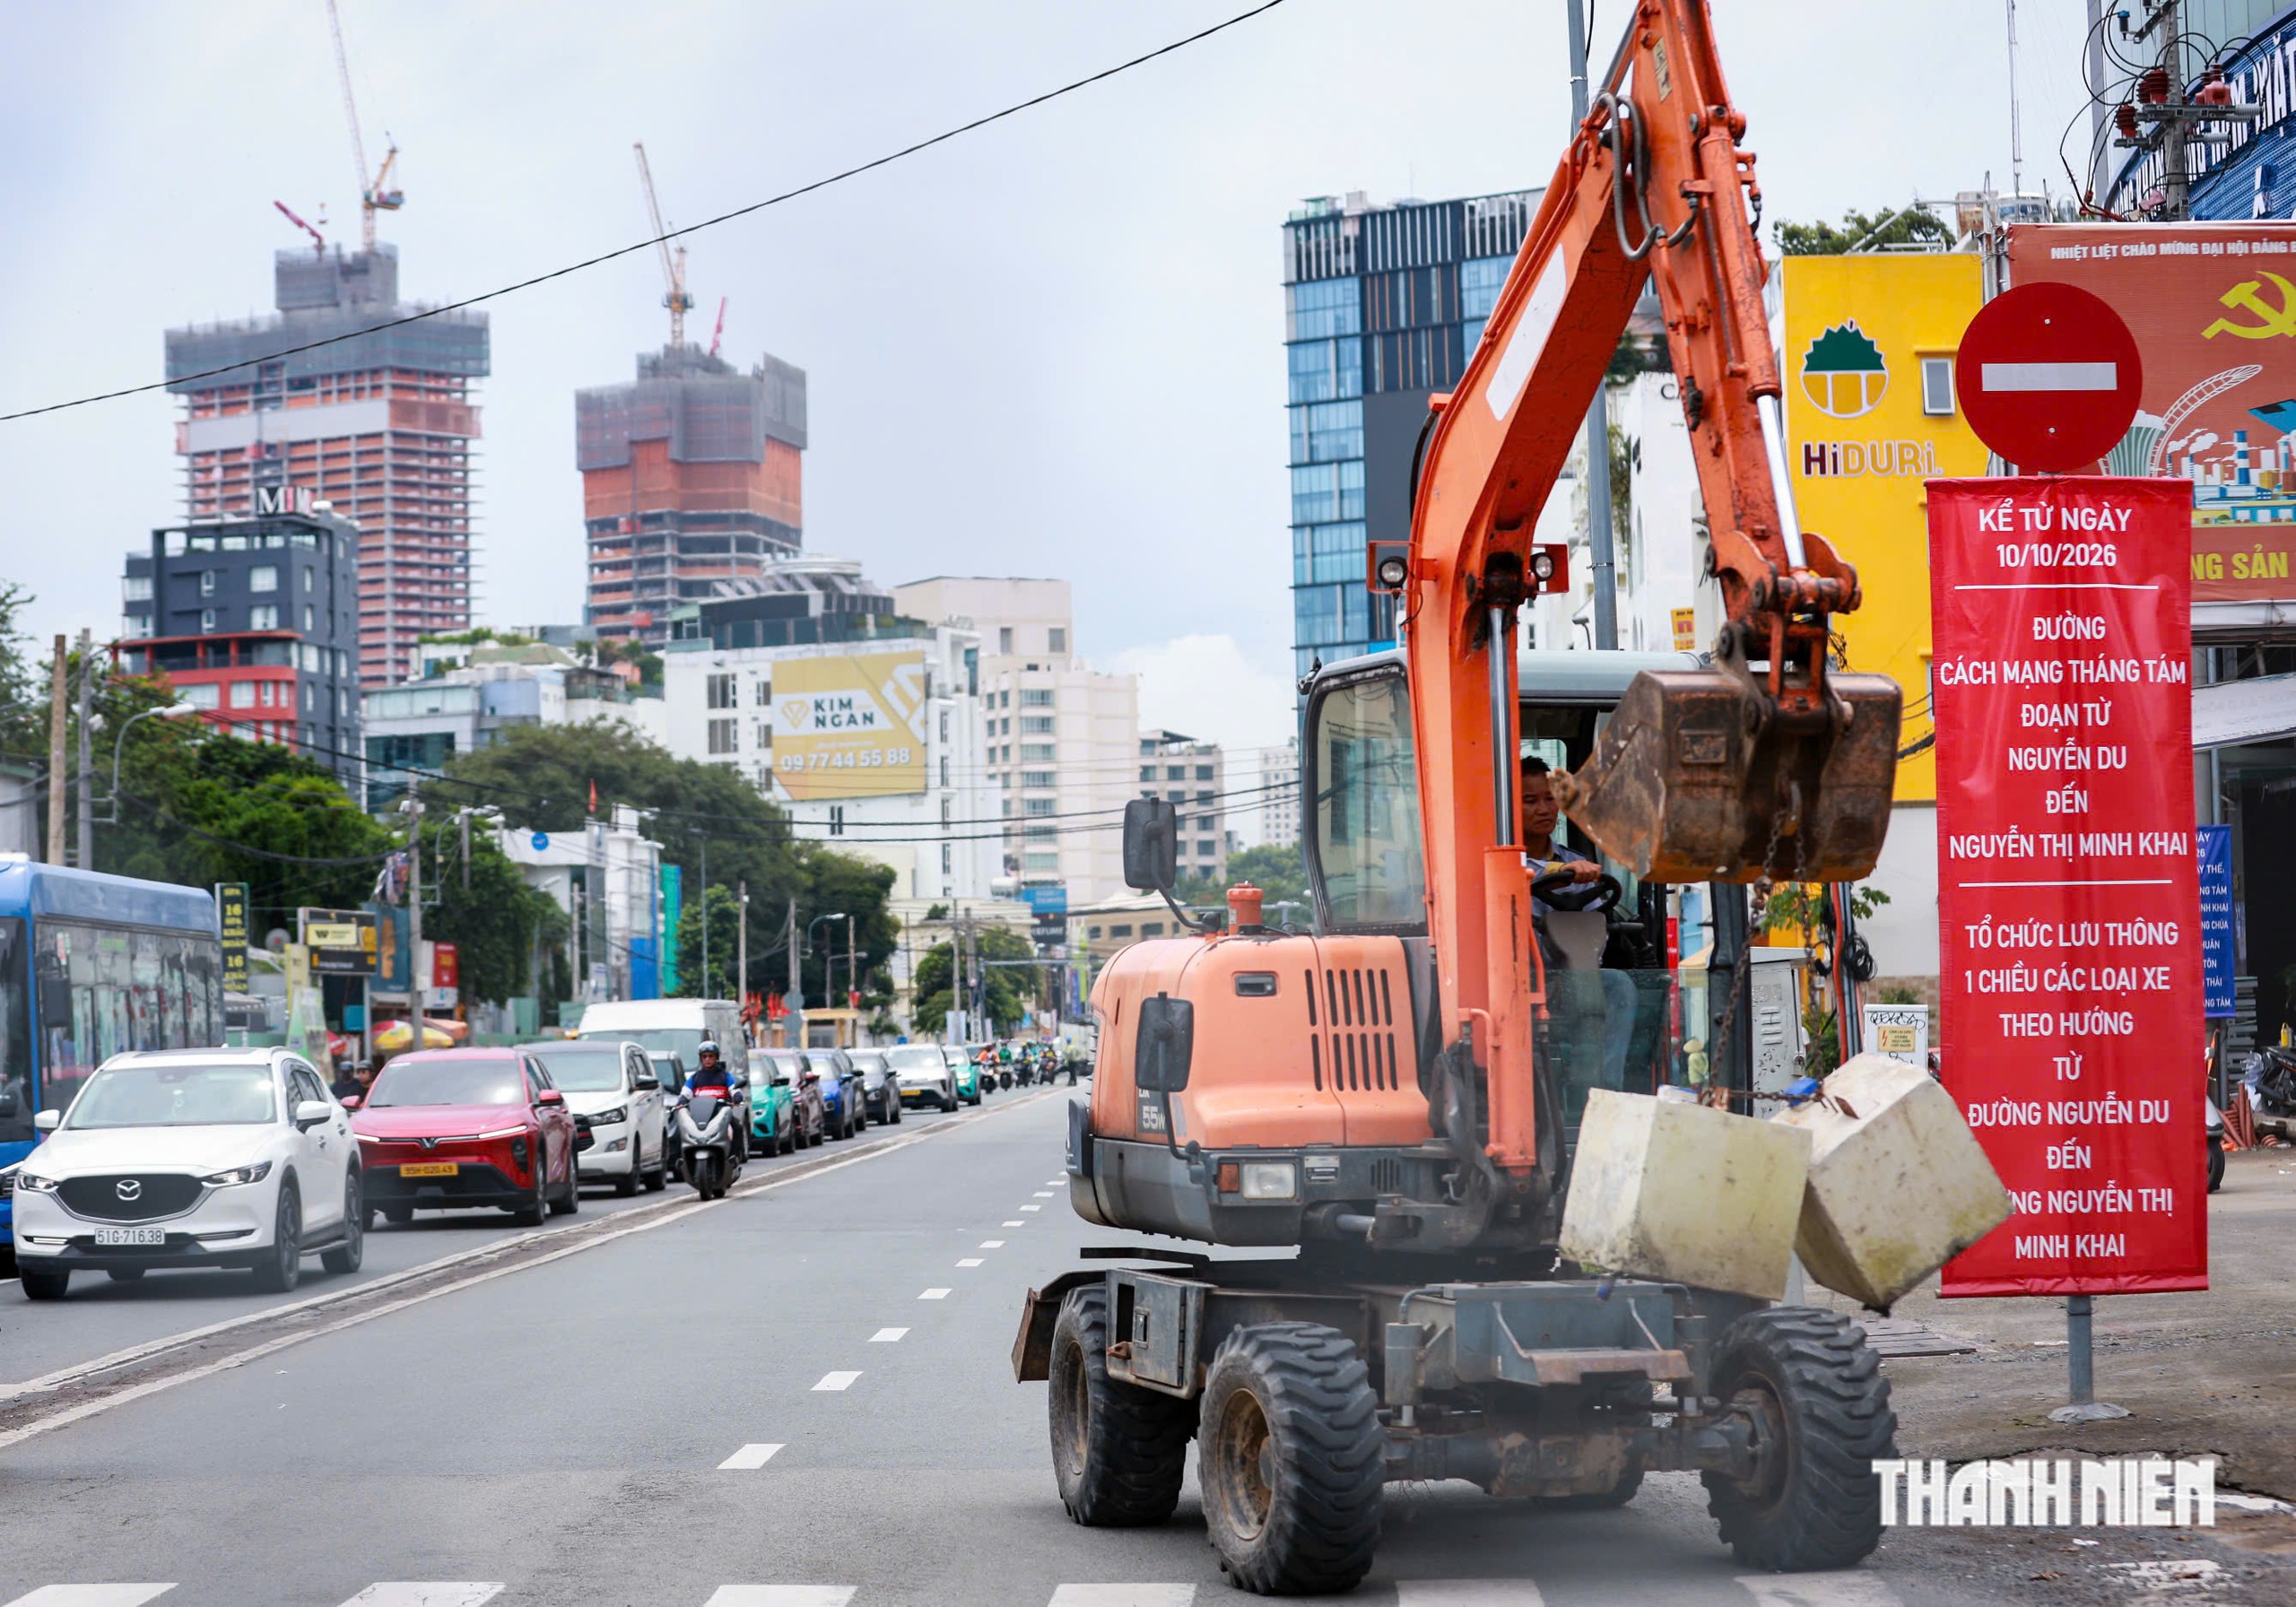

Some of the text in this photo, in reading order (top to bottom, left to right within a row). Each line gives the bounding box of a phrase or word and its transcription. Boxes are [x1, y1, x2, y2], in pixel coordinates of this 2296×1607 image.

[2050, 244, 2089, 261] NHIỆT
[2092, 243, 2118, 260] LIỆT
[2121, 241, 2157, 256] CHÀO
[2226, 239, 2249, 256] HỘI
[1979, 498, 2133, 532] KỂ TỪ NGÀY
[1996, 543, 2117, 568] 10/10/2026
[2191, 543, 2290, 581] NG SẢN
[2032, 611, 2106, 640] ĐƯỜNG
[1940, 652, 2186, 690] CÁCH MẠNG THÁNG TÁM
[814, 698, 852, 713] KIM
[814, 712, 874, 728] NGAN
[2021, 696, 2112, 733] ĐOẠN TỪ
[887, 747, 911, 765] 88
[2008, 737, 2126, 771] NGUYỄN DU
[2045, 780, 2088, 814] ĐẾN
[1950, 824, 2187, 863] NGUYỄN THỊ MINH KHAI
[225, 904, 242, 916] 16
[1964, 914, 2179, 949] TỔ CHỨC LƯU THÔNG
[227, 955, 244, 968] 16
[1965, 960, 2170, 996] 1 CHIỀU CÁC LOẠI XE
[1999, 1005, 2134, 1038] THEO HƯỚNG
[2052, 1050, 2083, 1081] TỪ
[1968, 1090, 2170, 1127] ĐƯỜNG NGUYỄN DU
[2046, 1137, 2091, 1169] ĐẾN
[2048, 1179, 2133, 1214] NGUYỄN
[2137, 1188, 2173, 1217] THỊ
[98, 1229, 162, 1244] 51G-716.38
[2015, 1233, 2125, 1259] MINH KHAI
